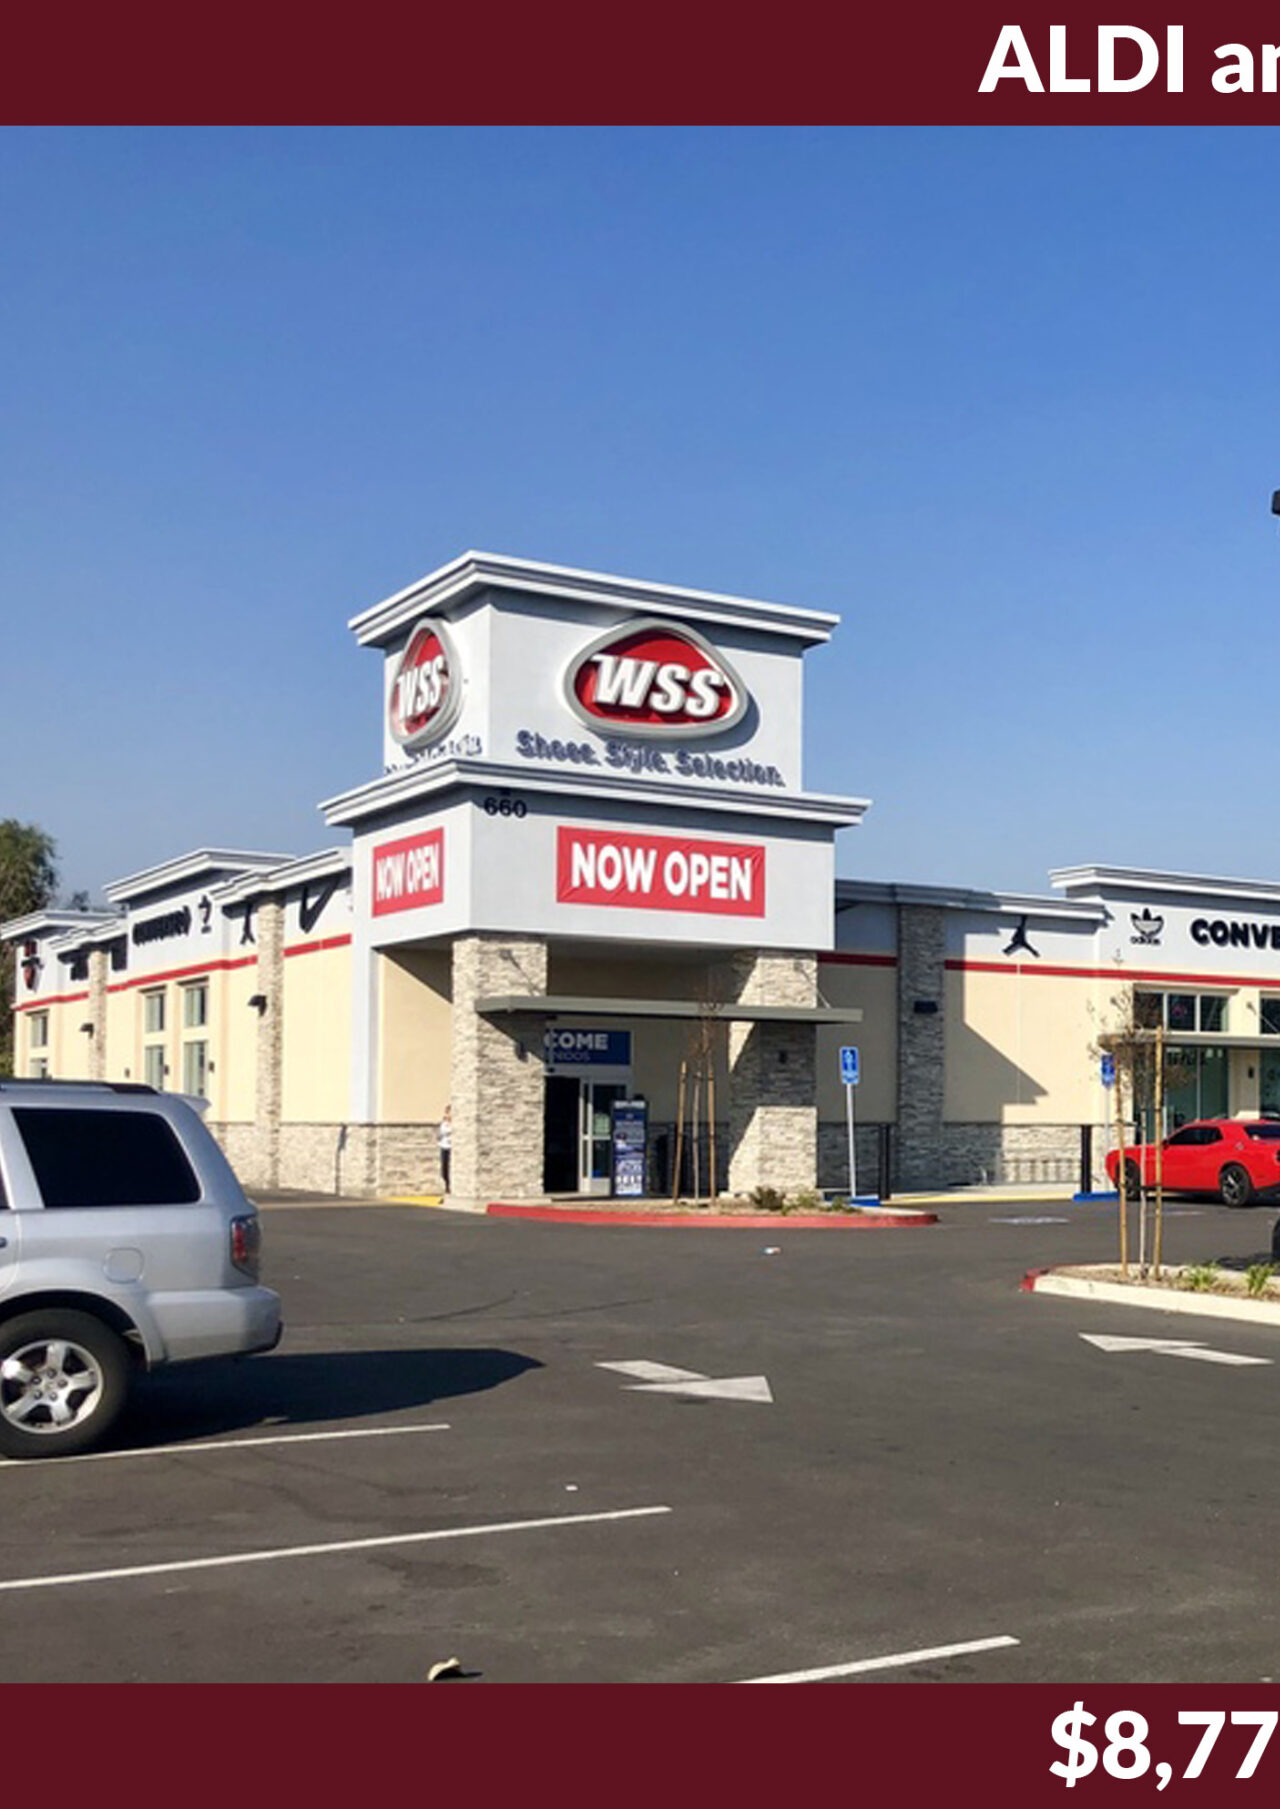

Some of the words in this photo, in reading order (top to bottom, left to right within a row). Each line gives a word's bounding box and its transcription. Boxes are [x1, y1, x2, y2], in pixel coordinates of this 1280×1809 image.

[397, 655, 446, 720] WSS
[591, 654, 724, 717] WSS
[484, 797, 527, 818] 660
[376, 852, 405, 902] NOW
[406, 842, 440, 894] OPEN
[570, 841, 656, 893] NOW
[664, 850, 752, 900] OPEN
